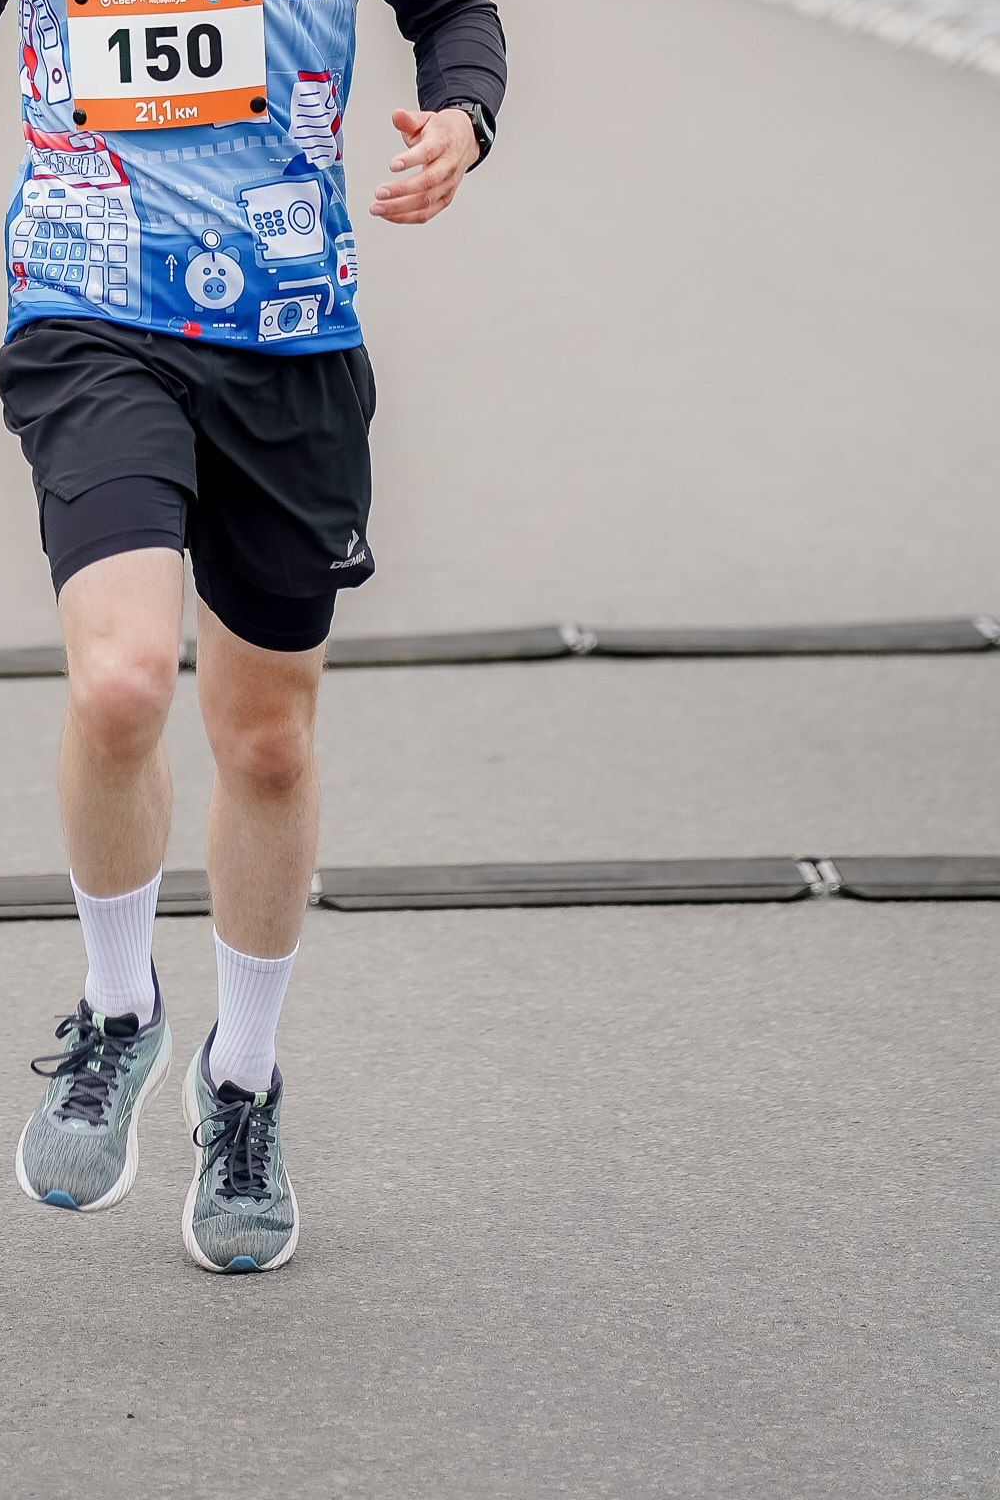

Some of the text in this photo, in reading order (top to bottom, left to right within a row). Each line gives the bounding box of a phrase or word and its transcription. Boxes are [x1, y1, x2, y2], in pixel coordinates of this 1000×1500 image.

[108, 23, 223, 84] 150
[135, 100, 198, 125] 21,1 км
[36, 245, 43, 256] 4
[75, 246, 82, 256] 6
[49, 267, 58, 277] 2
[71, 268, 78, 279] 3
[330, 549, 366, 569] DEMIX
